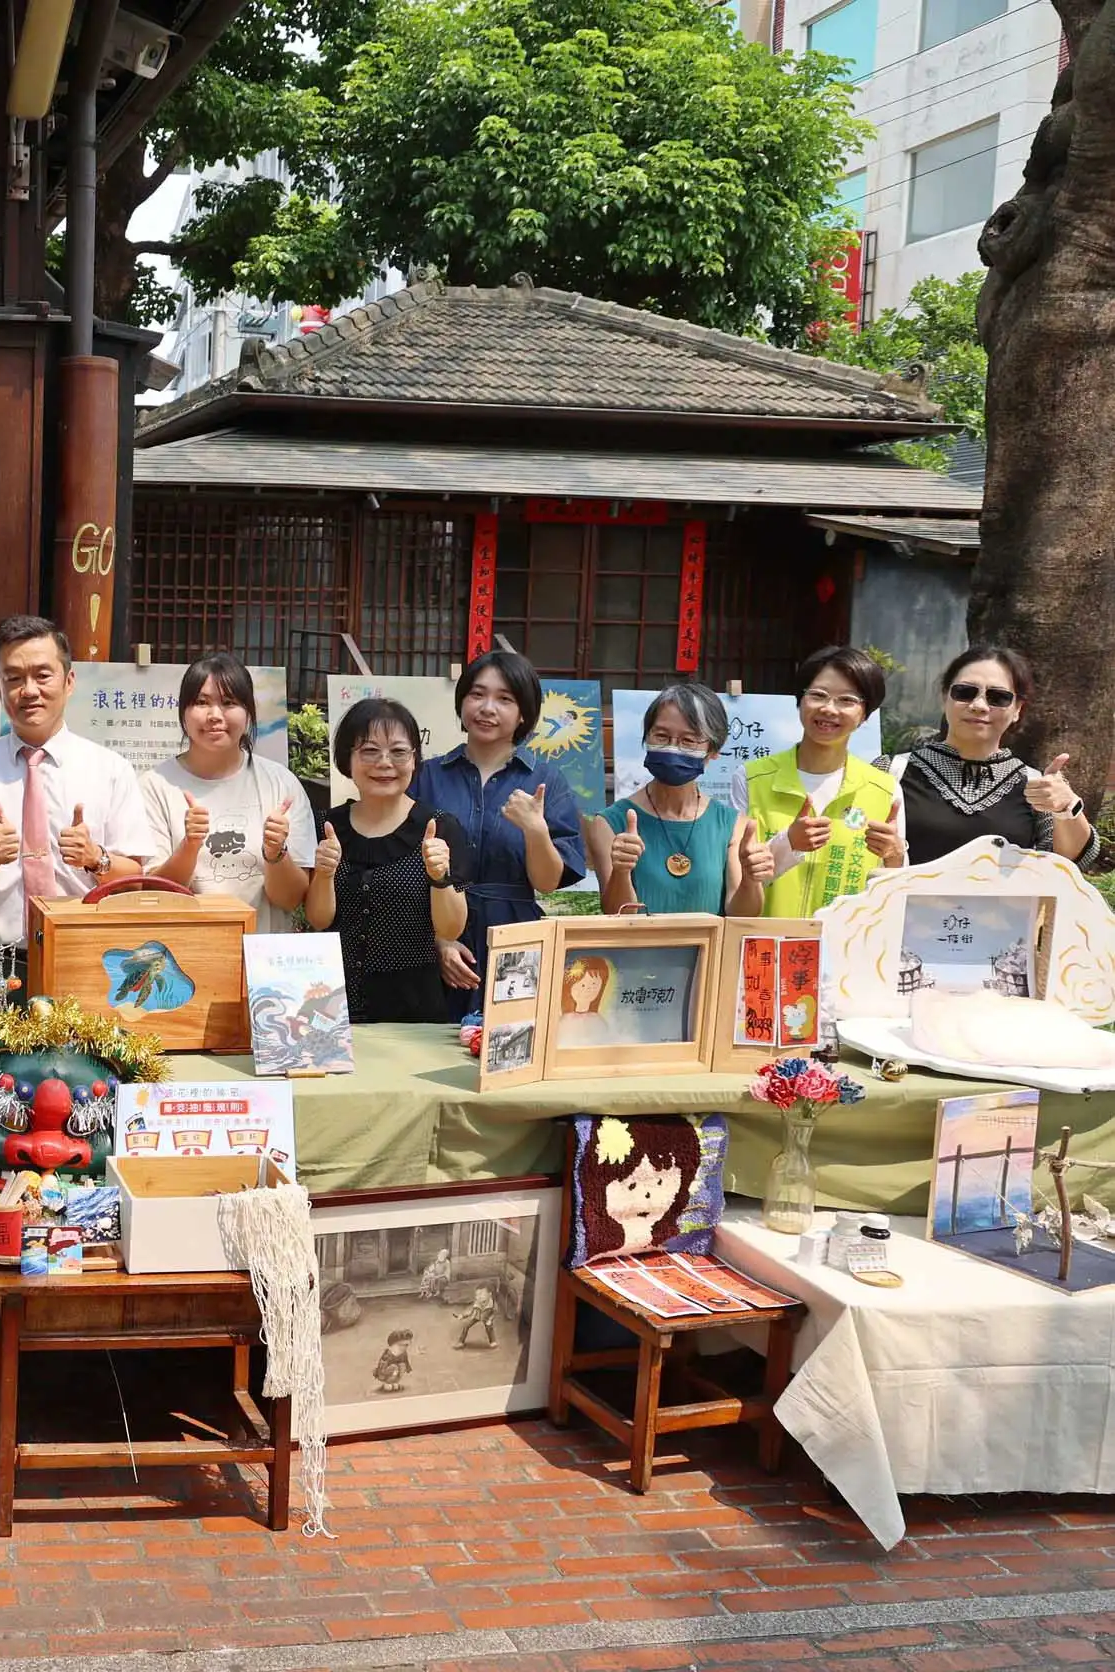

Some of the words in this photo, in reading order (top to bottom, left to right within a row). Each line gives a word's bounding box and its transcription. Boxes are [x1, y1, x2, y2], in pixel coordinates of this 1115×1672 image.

[72, 523, 115, 576] GO
[621, 986, 675, 1004] 放電巧克力
